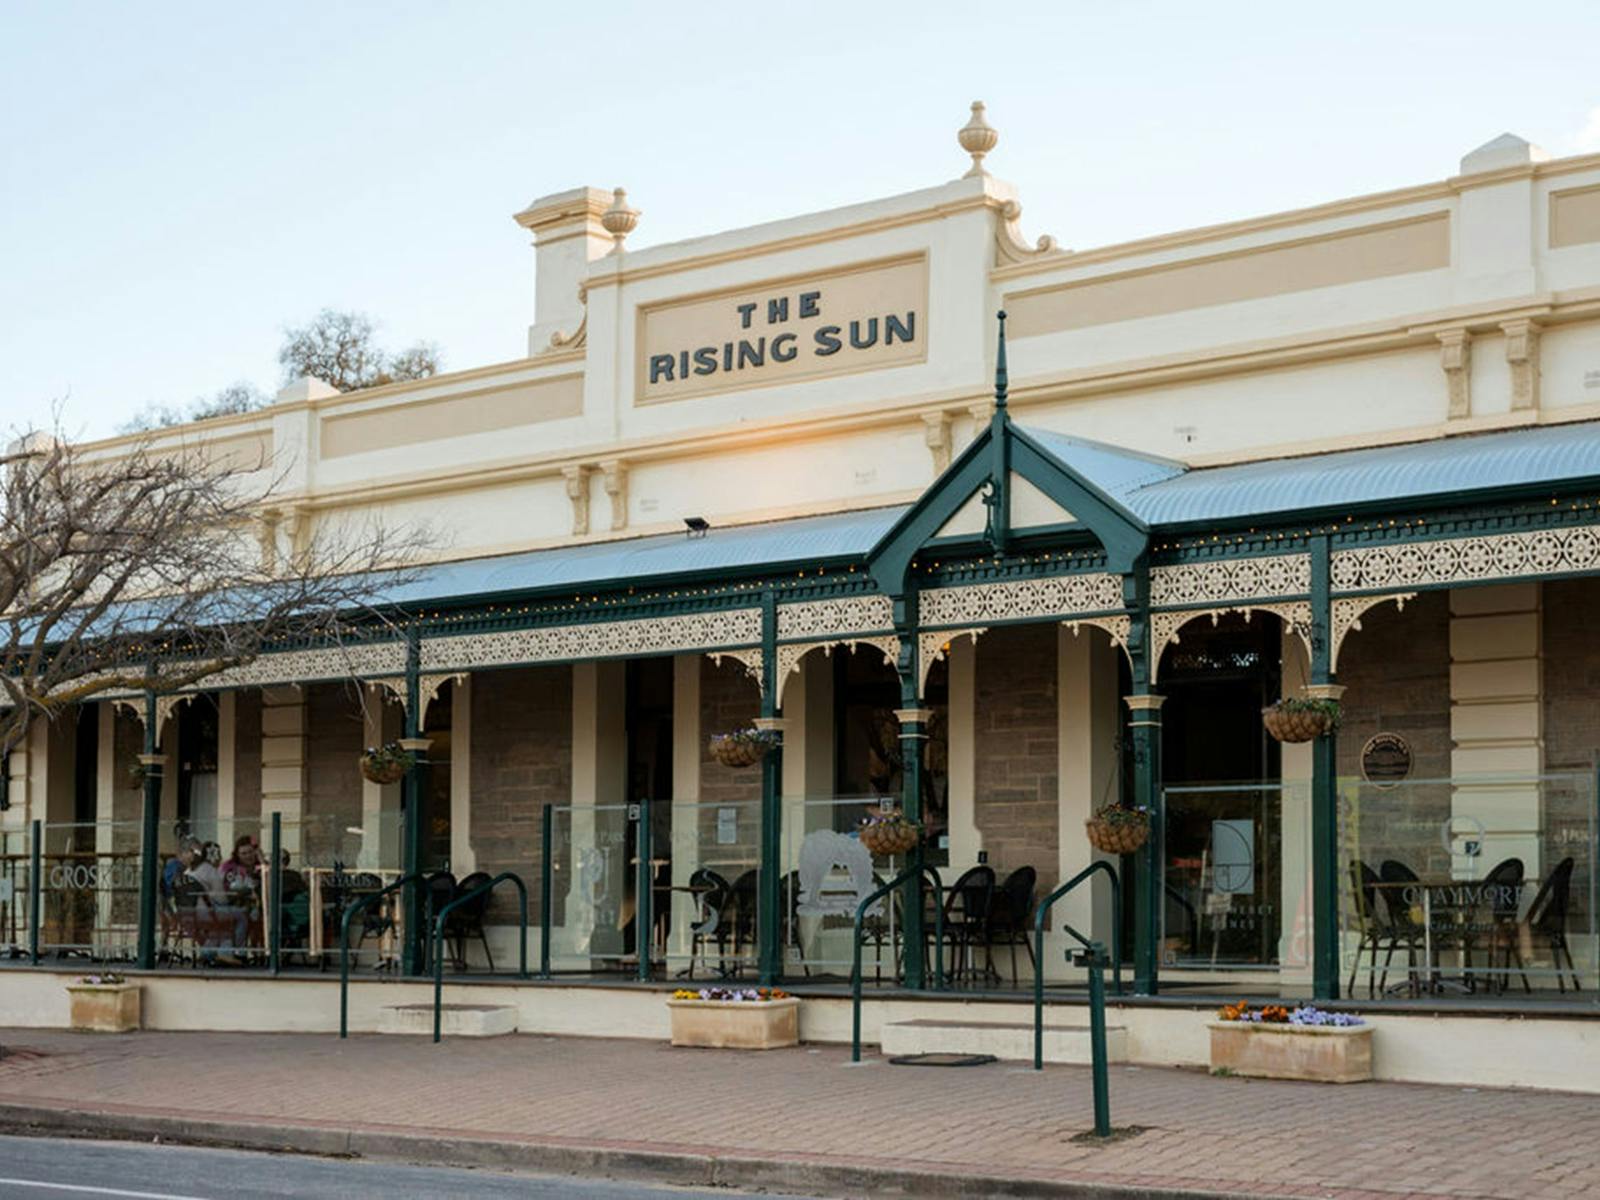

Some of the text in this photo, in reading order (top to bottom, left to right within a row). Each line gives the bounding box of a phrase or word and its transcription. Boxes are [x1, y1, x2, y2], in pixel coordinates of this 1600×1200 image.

[737, 291, 821, 329] THE
[649, 311, 915, 384] RISING SUN
